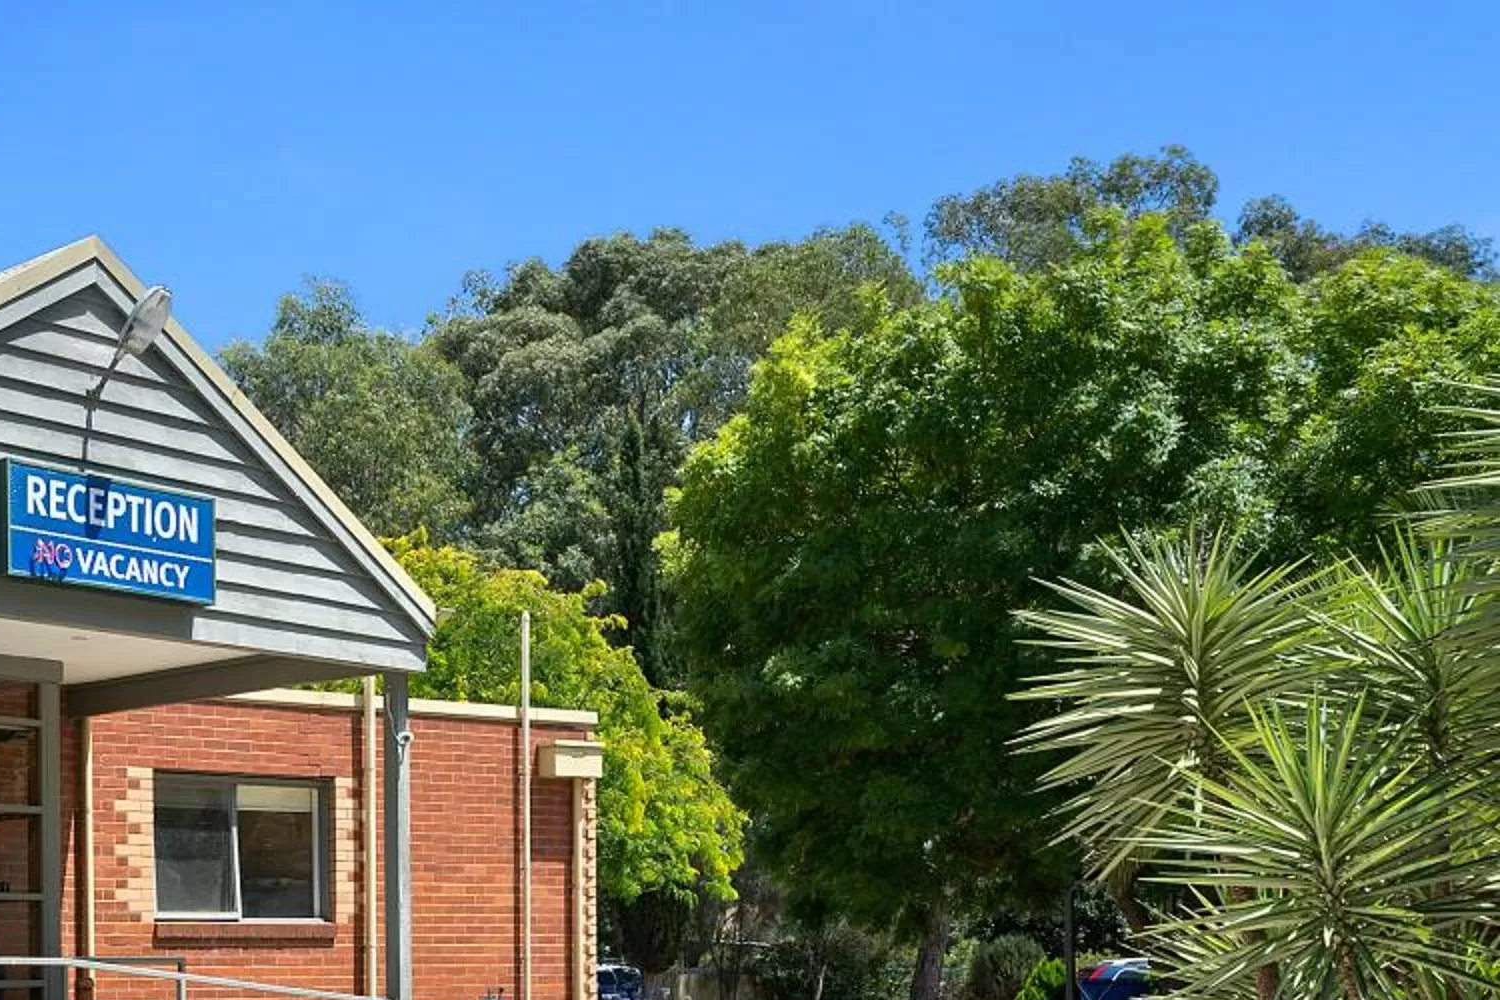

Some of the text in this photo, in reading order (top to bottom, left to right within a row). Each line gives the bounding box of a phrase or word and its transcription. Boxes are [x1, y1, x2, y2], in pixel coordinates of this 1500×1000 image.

[26, 475, 198, 544] RECEPTION
[35, 539, 190, 589] NO VACANCY
